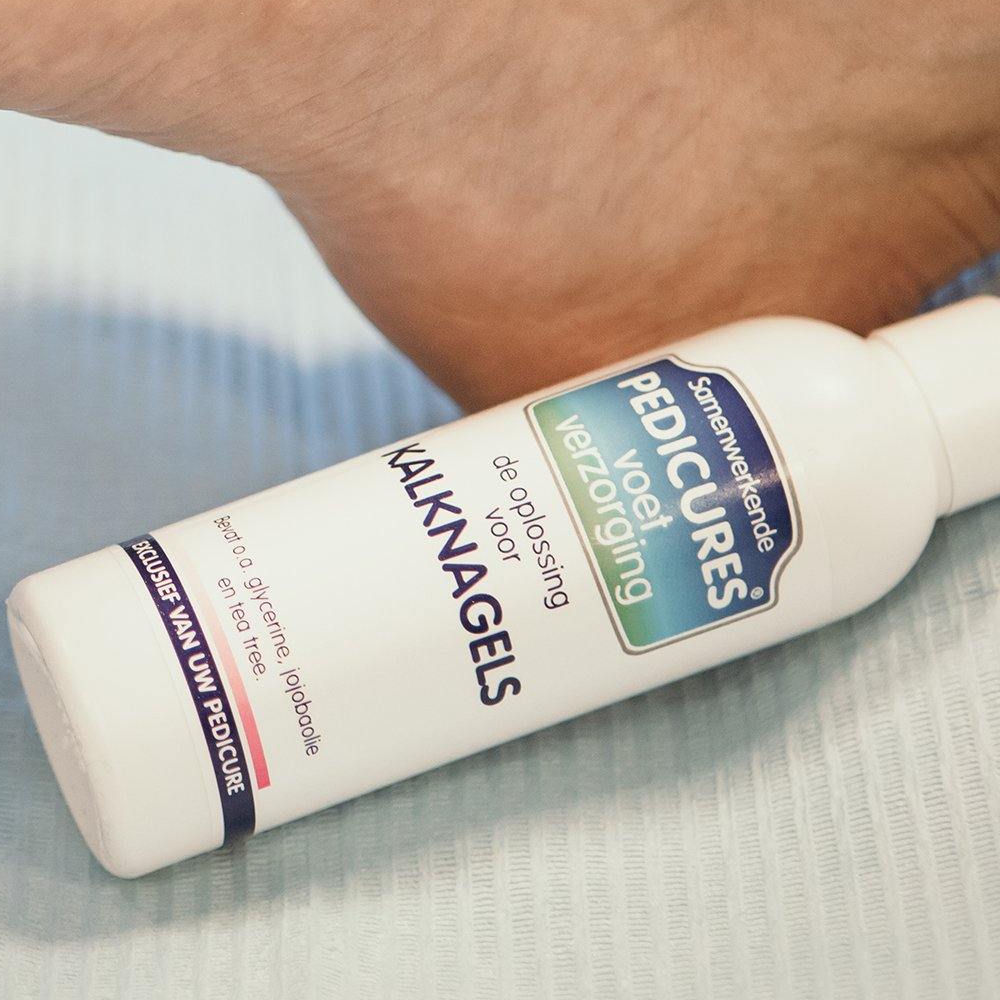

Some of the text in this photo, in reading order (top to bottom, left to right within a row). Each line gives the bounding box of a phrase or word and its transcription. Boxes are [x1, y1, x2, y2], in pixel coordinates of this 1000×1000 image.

[485, 507, 521, 561] voor
[492, 455, 570, 609] de oplossing
[555, 414, 653, 606] verzorging
[613, 448, 673, 531] voet
[688, 376, 777, 553] Samenwerkende
[214, 515, 321, 756] Bevat o.a. glycerine, jojobaolie
[217, 577, 266, 681] en tea tree.
[381, 442, 521, 706] KALKNAGELS
[132, 540, 245, 796] EXCLUSIEF VAN UW PEDICURE
